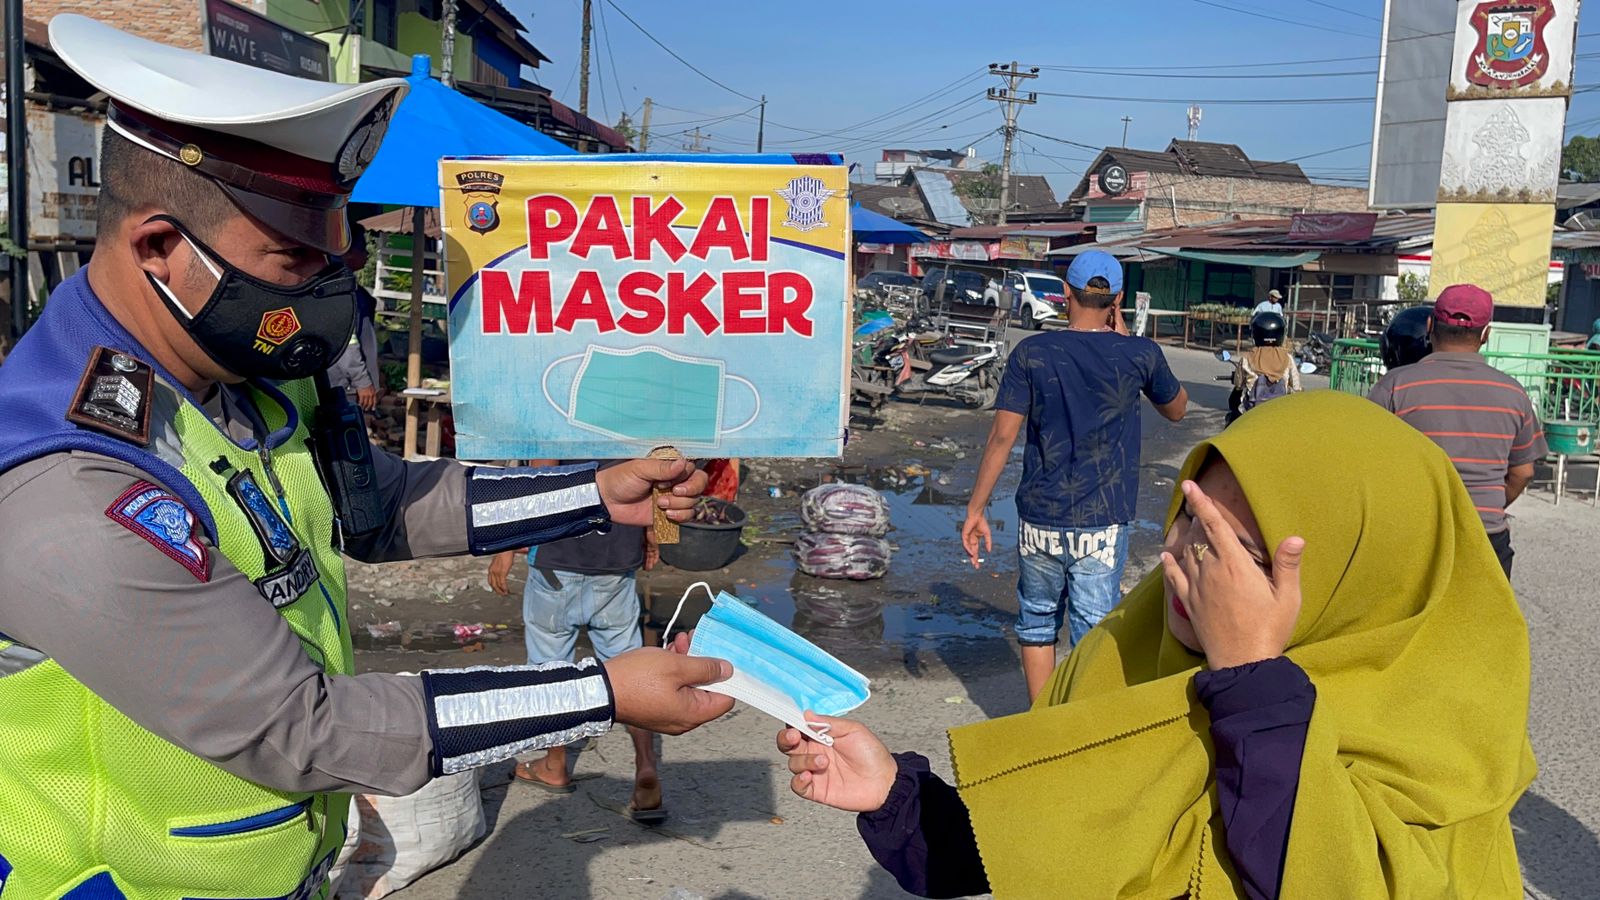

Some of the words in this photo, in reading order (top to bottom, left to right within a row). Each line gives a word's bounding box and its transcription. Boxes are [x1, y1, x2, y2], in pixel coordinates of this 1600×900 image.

[212, 26, 257, 61] WAVE
[460, 171, 500, 181] POLRES
[527, 195, 770, 263] PAKAI
[479, 269, 814, 337] MASKER
[253, 339, 275, 355] TNI
[270, 557, 315, 602] ANDRY
